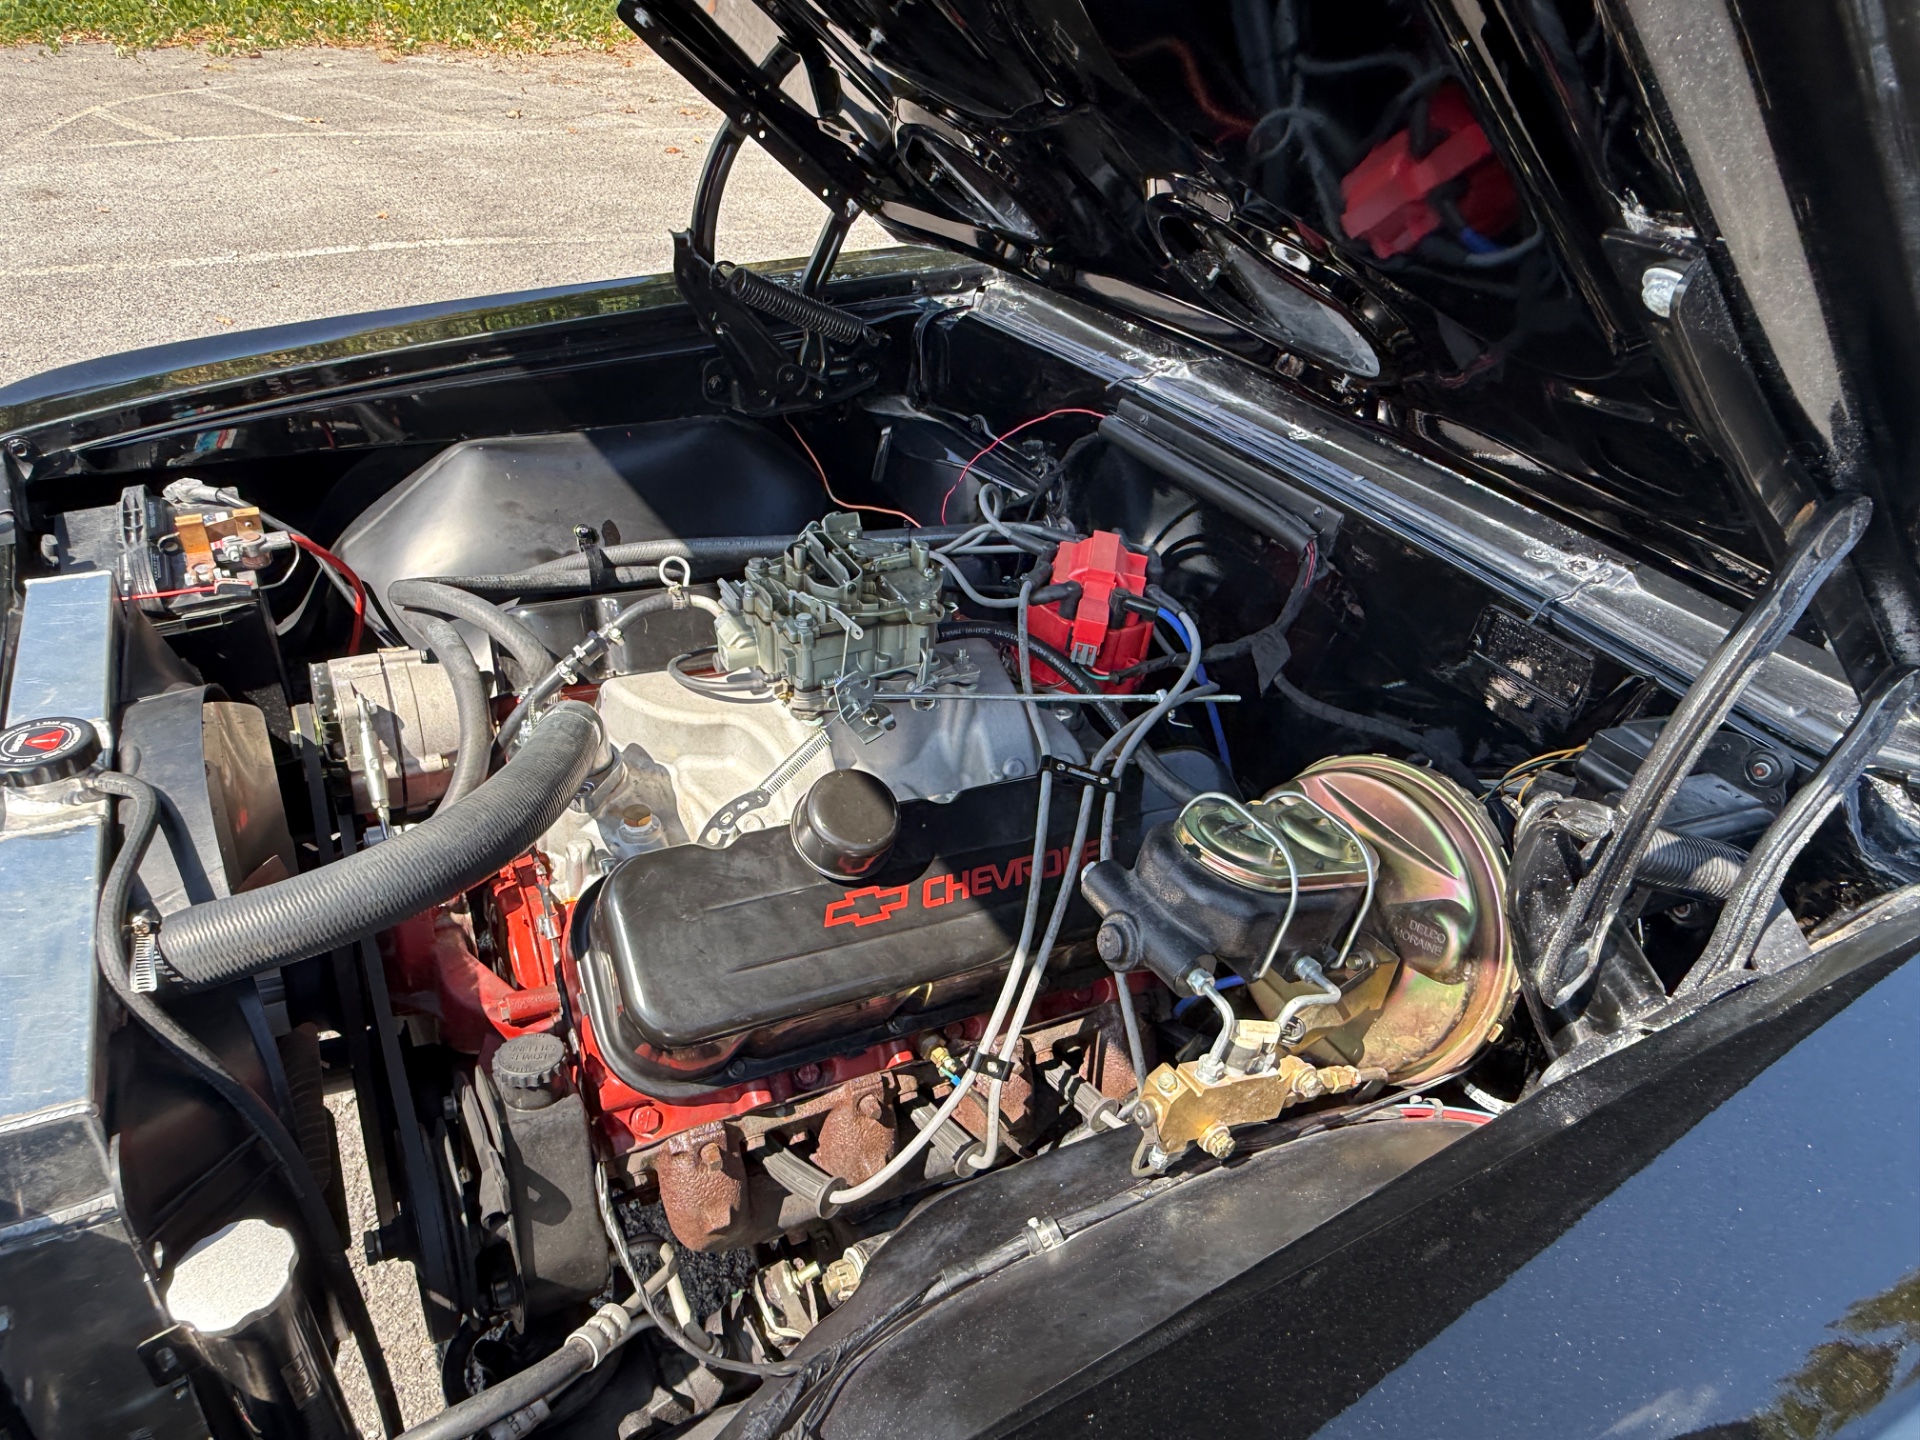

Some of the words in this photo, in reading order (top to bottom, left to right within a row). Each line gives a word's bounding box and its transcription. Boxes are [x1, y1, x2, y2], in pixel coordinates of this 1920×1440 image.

[922, 834, 1120, 909] CHEVROLE
[1393, 926, 1444, 957] MORAINE
[1409, 919, 1447, 944] DELCO
